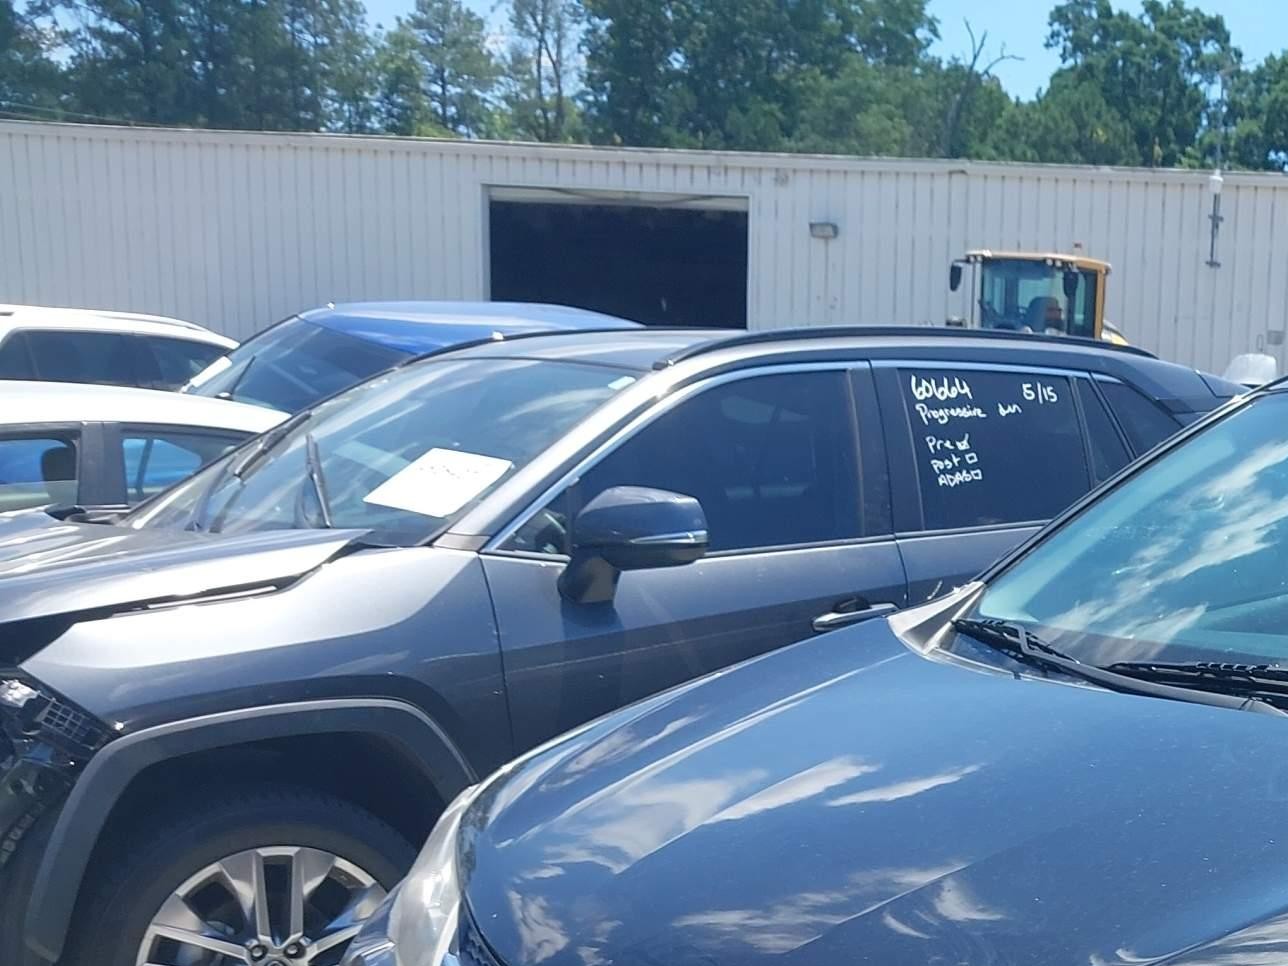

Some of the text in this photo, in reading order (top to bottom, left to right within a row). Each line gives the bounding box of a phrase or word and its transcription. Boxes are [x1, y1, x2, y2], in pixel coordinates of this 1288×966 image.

[1021, 382, 1059, 404] 5/15
[914, 403, 988, 426] Progressive
[925, 435, 955, 454] Pre
[937, 469, 973, 488] ADAS
